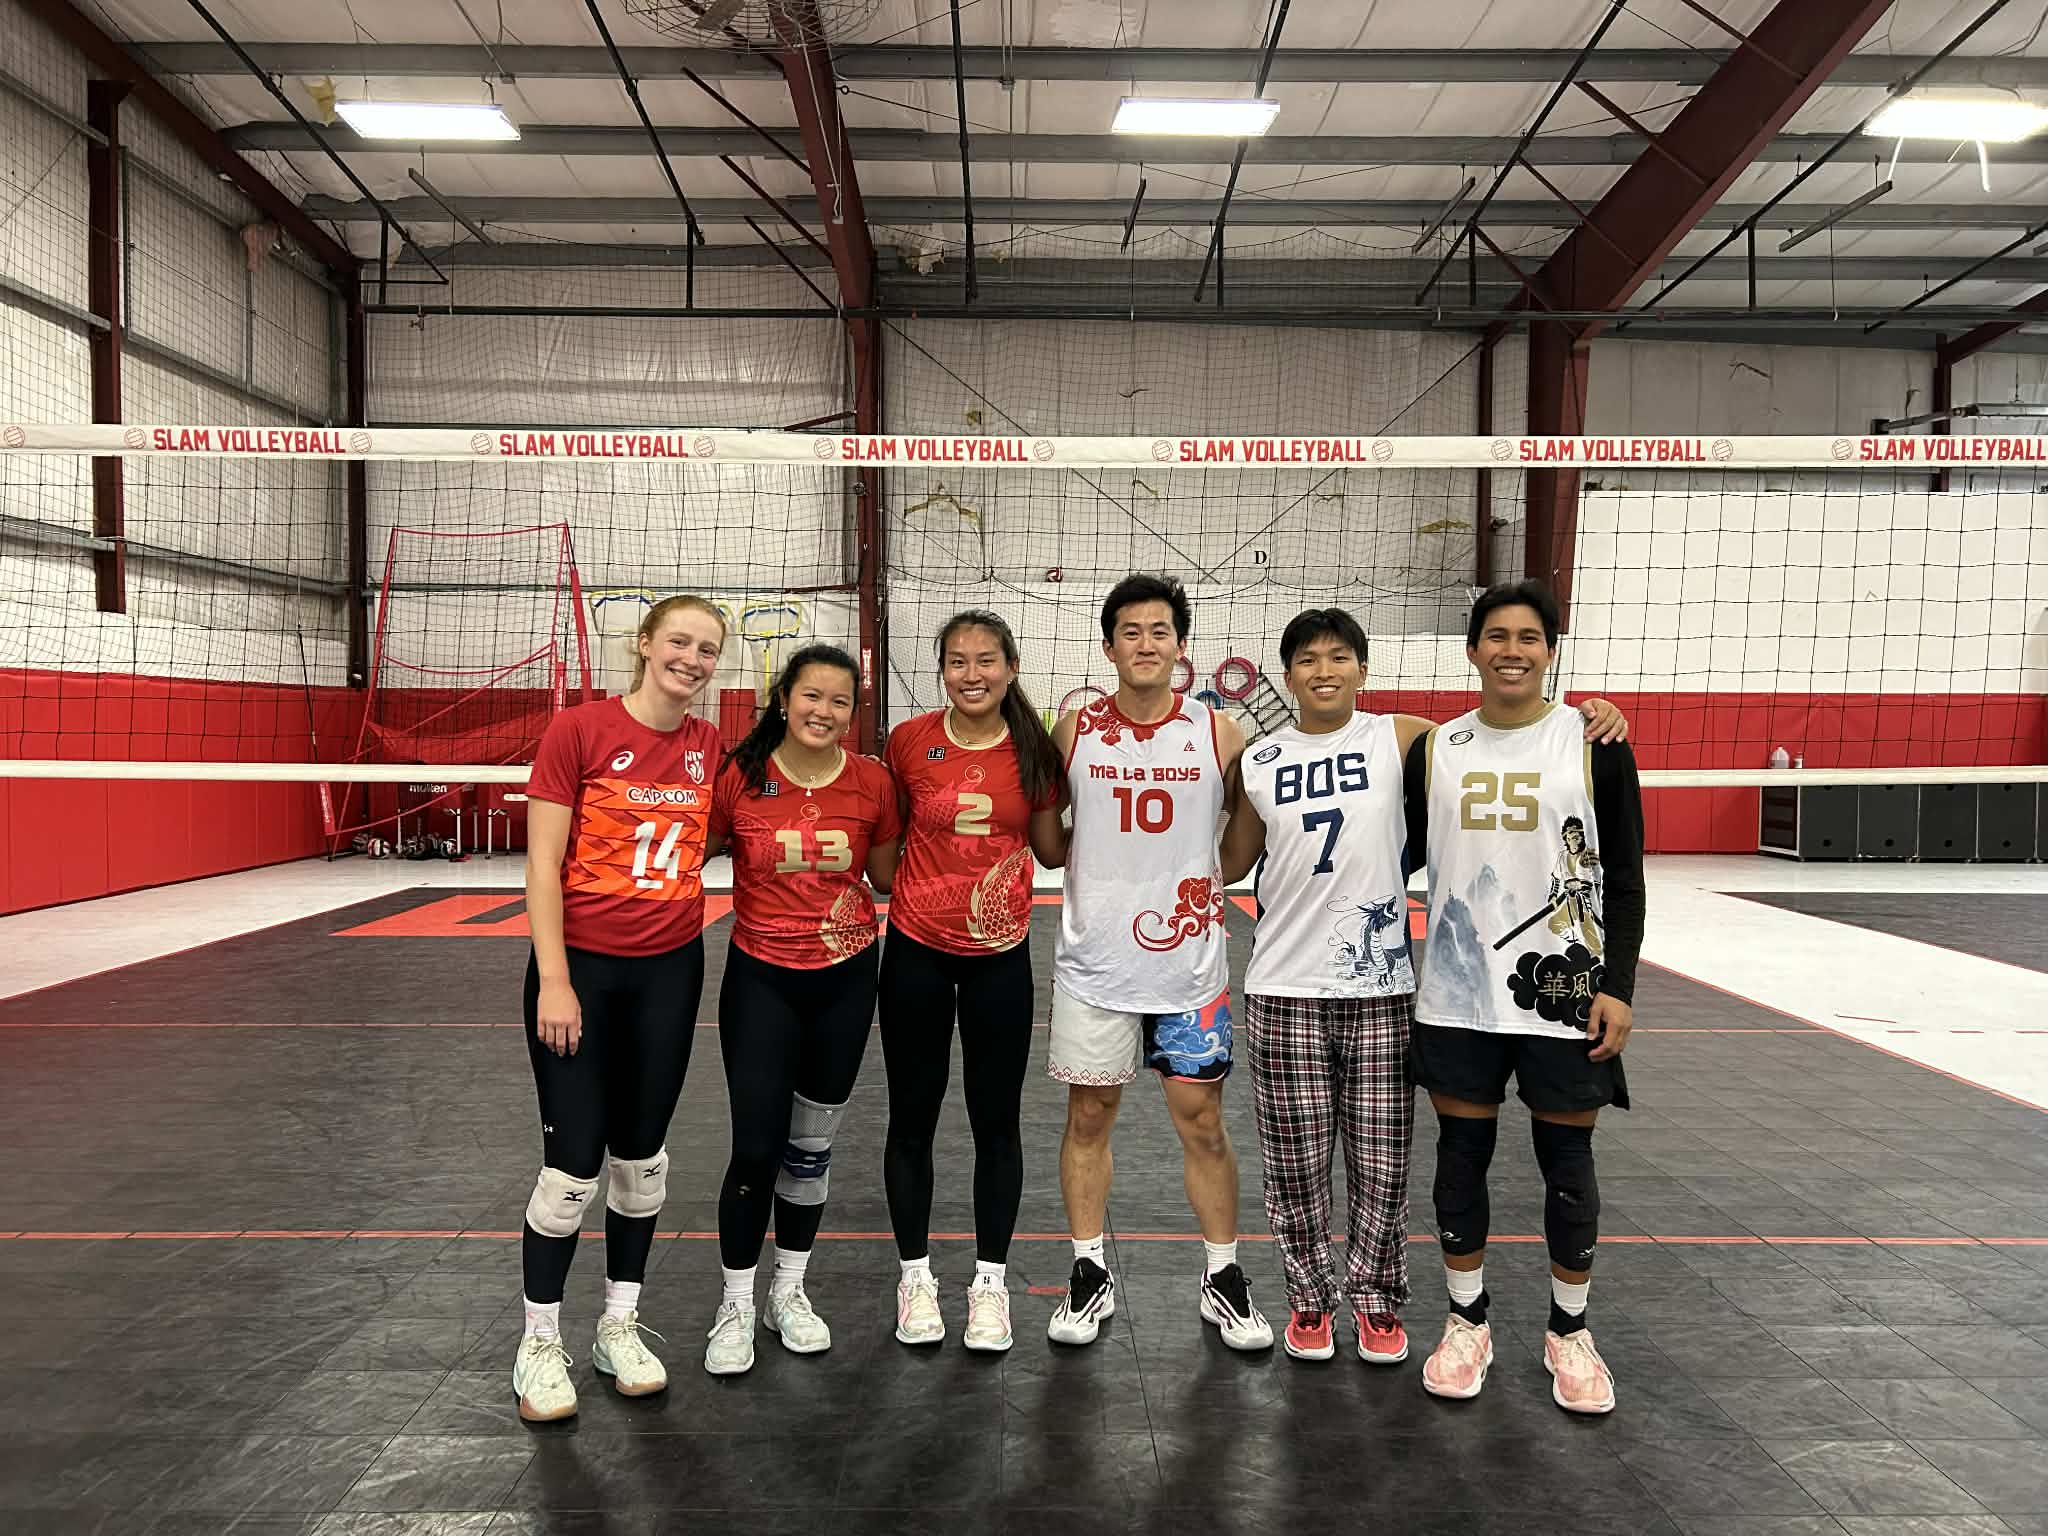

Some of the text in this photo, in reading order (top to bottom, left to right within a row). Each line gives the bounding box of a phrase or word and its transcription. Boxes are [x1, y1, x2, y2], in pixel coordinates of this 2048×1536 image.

[153, 429, 345, 454] SLAM VOLLEYBALL
[499, 434, 689, 458] SLAM VOLLEYBALL
[842, 438, 1028, 462] SLAM VOLLEYBALL
[1180, 440, 1366, 462] SLAM VOLLEYBALL
[1519, 439, 1705, 462] SLAM VOLLEYBALL
[1860, 439, 2046, 461] SLAM VOLLEYBALL
[1254, 550, 1268, 564] D
[1274, 752, 1369, 806] BOS
[627, 786, 697, 805] CAPCOM
[1112, 786, 1174, 834] 10
[1460, 771, 1541, 831] 25
[954, 793, 993, 835] 2
[631, 821, 684, 889] 14
[775, 829, 853, 873] 13
[1302, 807, 1345, 876] 7
[1537, 970, 1595, 1005] 華風
